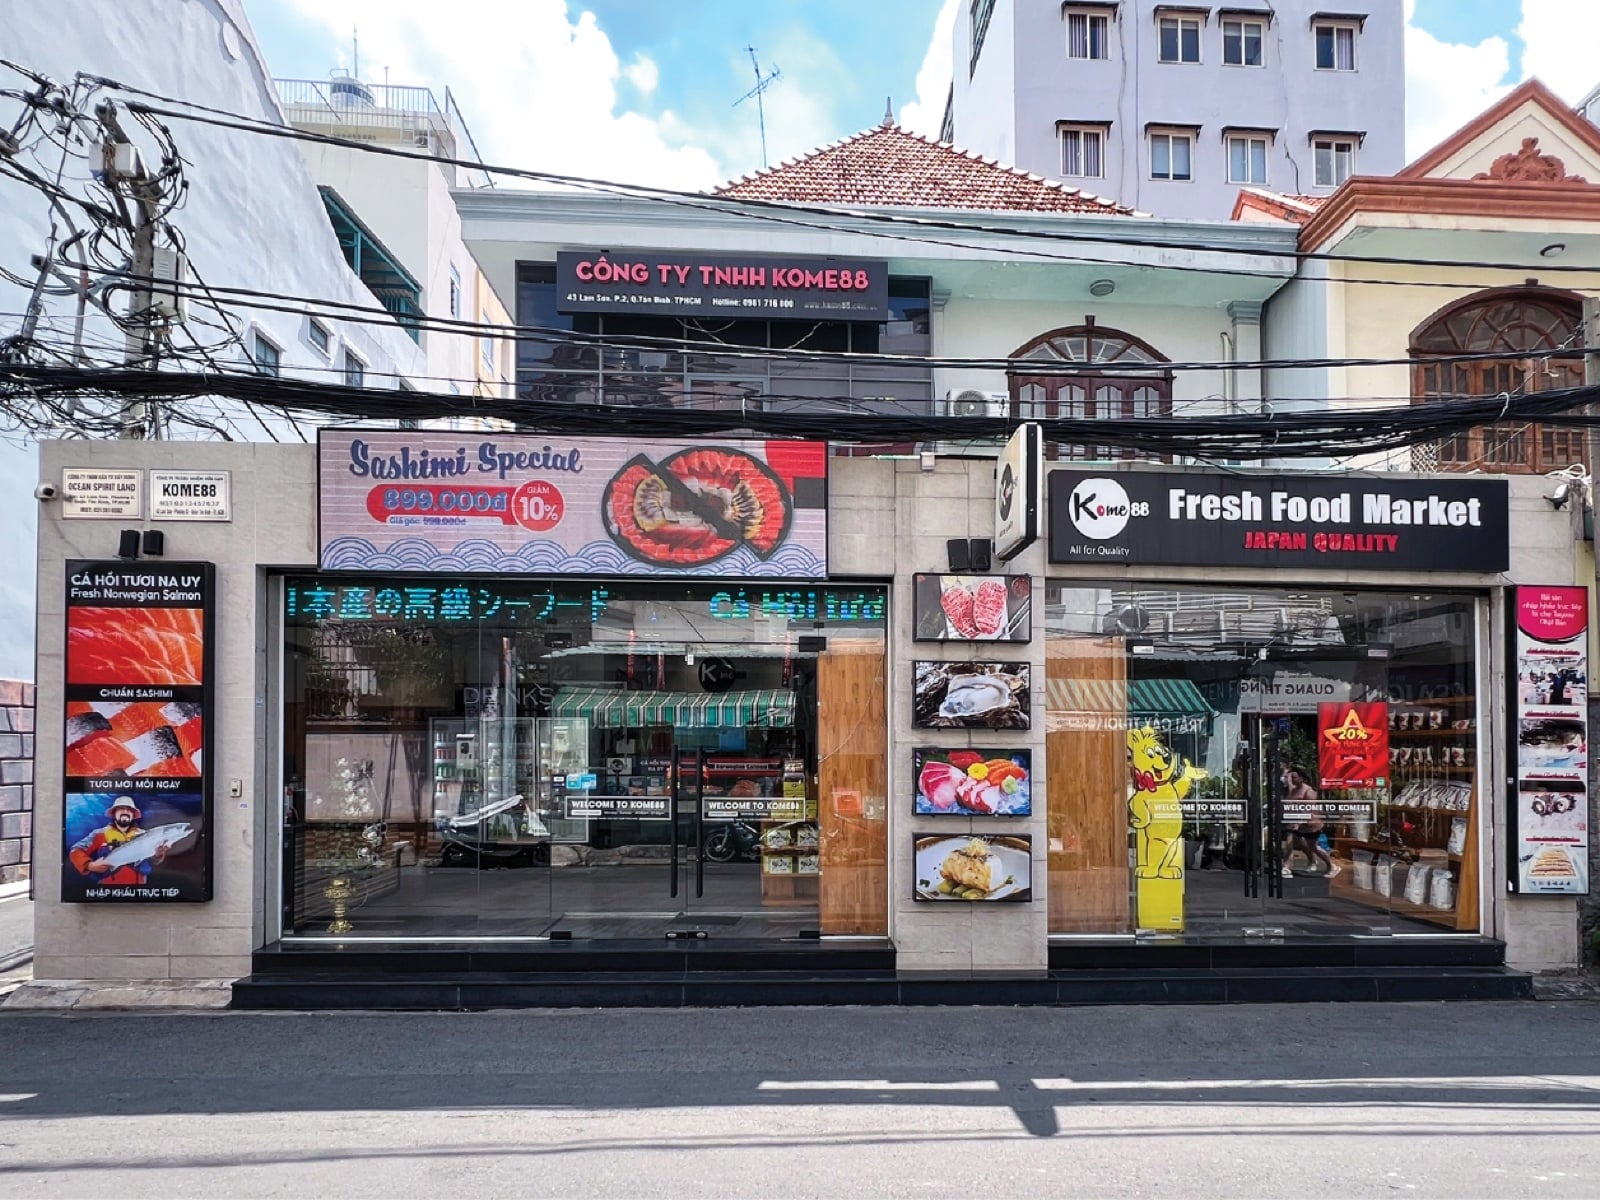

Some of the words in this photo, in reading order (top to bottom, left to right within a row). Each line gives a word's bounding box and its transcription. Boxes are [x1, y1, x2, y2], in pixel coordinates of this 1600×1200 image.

[576, 256, 649, 282] CÔNG
[657, 264, 691, 284] TY
[699, 265, 765, 286] TNHH
[772, 268, 869, 289] KOME88
[566, 293, 577, 301] 43
[712, 298, 741, 307] Hotline:
[350, 439, 470, 479] Sashimi
[478, 442, 583, 480] Special
[68, 482, 91, 491] OCEAN
[93, 482, 116, 491] SPIRIT
[117, 483, 136, 492] LAND
[162, 483, 217, 497] KOME88
[383, 488, 508, 512] 899.000đ
[519, 497, 558, 521] 10%
[1169, 488, 1262, 522] Fresh
[1271, 491, 1351, 523] Food
[1362, 494, 1481, 527] Market
[1244, 531, 1307, 550] JAPAN
[1313, 532, 1399, 552] QUALITY
[1069, 545, 1082, 555] All
[1083, 545, 1096, 555] for
[1097, 546, 1130, 556] Quality
[70, 571, 92, 586] CÁ
[95, 570, 119, 586] HỒI
[122, 574, 155, 587] TƯƠI
[158, 575, 179, 587] NA
[181, 576, 201, 588] UY
[70, 588, 101, 599] Fresh
[103, 588, 160, 602] Norwegian
[162, 589, 201, 601] Salmon
[136, 688, 173, 698] SASHIMI
[1338, 729, 1367, 740] 20%
[571, 800, 614, 809] WELCOME
[616, 801, 628, 809] TO
[630, 801, 665, 809] KOME88
[708, 801, 750, 810] WELCOME
[752, 802, 764, 810] TO
[766, 802, 800, 810] KOME88
[1154, 803, 1196, 812] WELCOME
[1197, 804, 1208, 812] TO
[1283, 804, 1324, 812] WELCOME
[1325, 804, 1336, 812] TO
